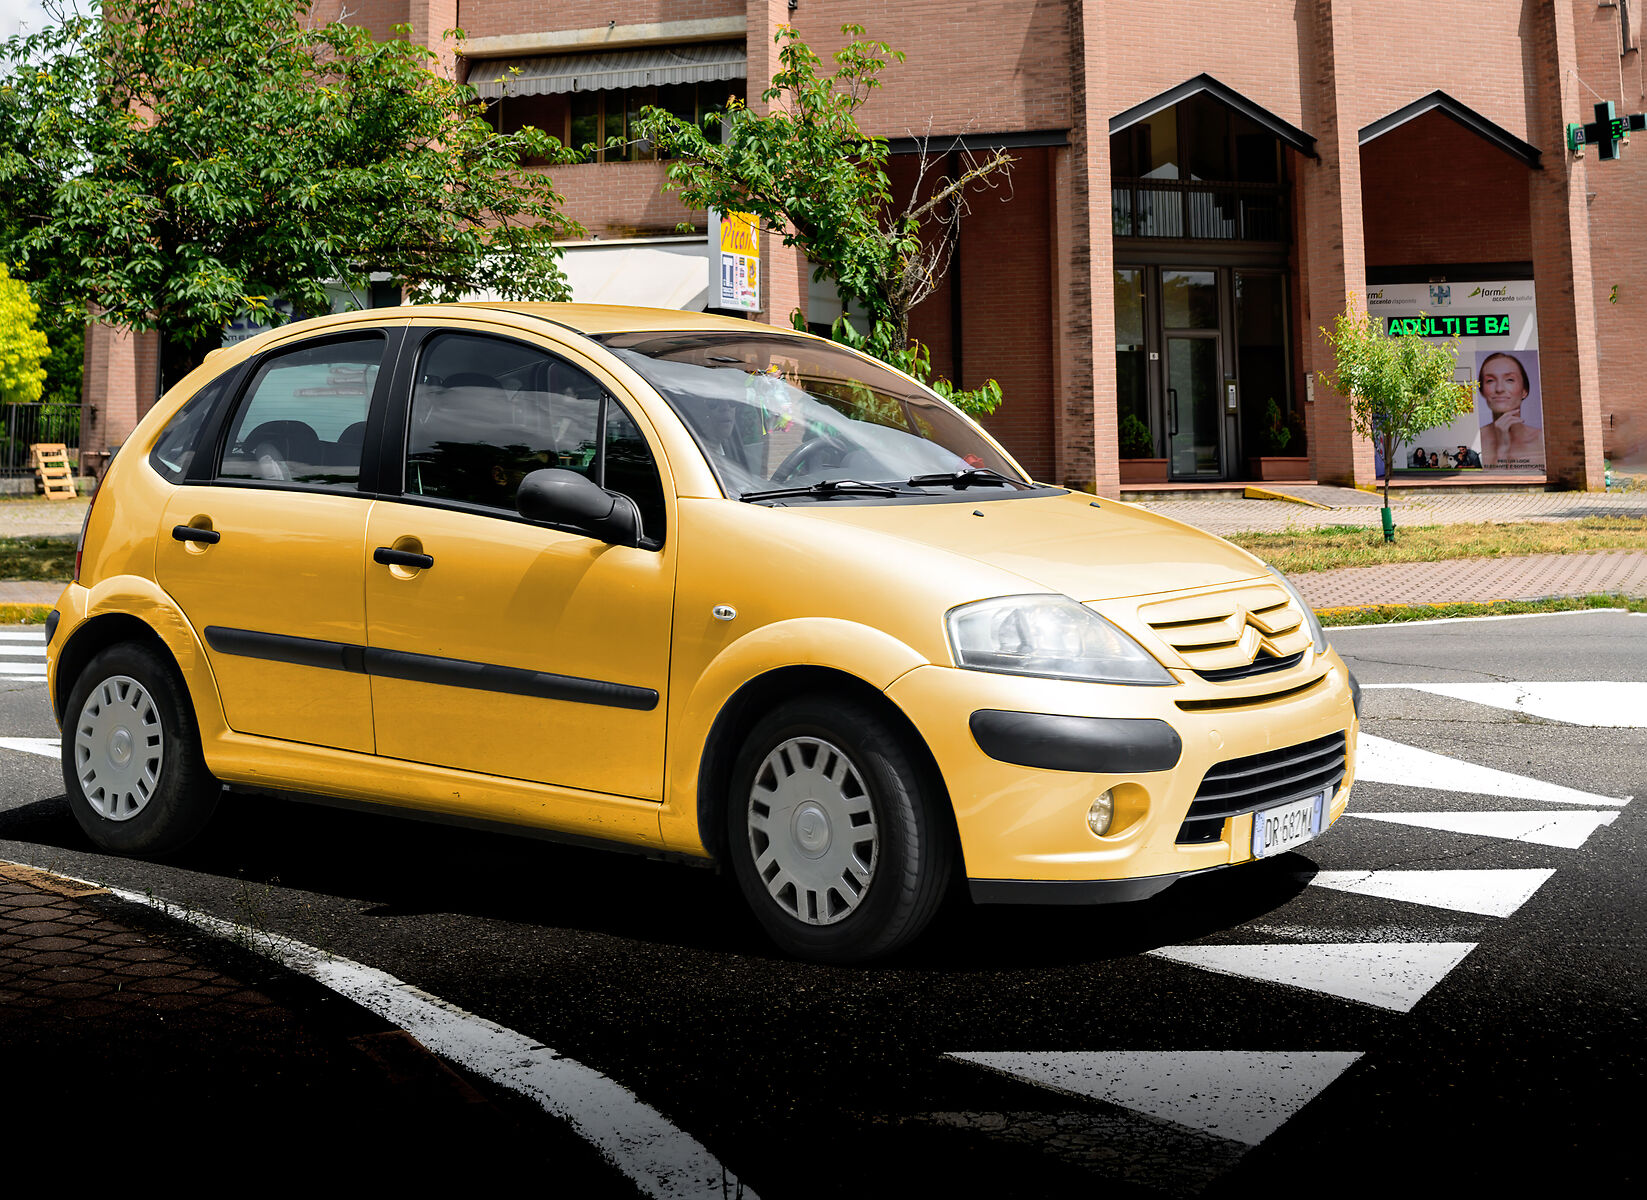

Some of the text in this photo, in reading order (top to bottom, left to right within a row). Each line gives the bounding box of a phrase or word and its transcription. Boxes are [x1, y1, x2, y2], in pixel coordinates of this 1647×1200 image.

[1388, 316, 1510, 336] ADULTI E BA
